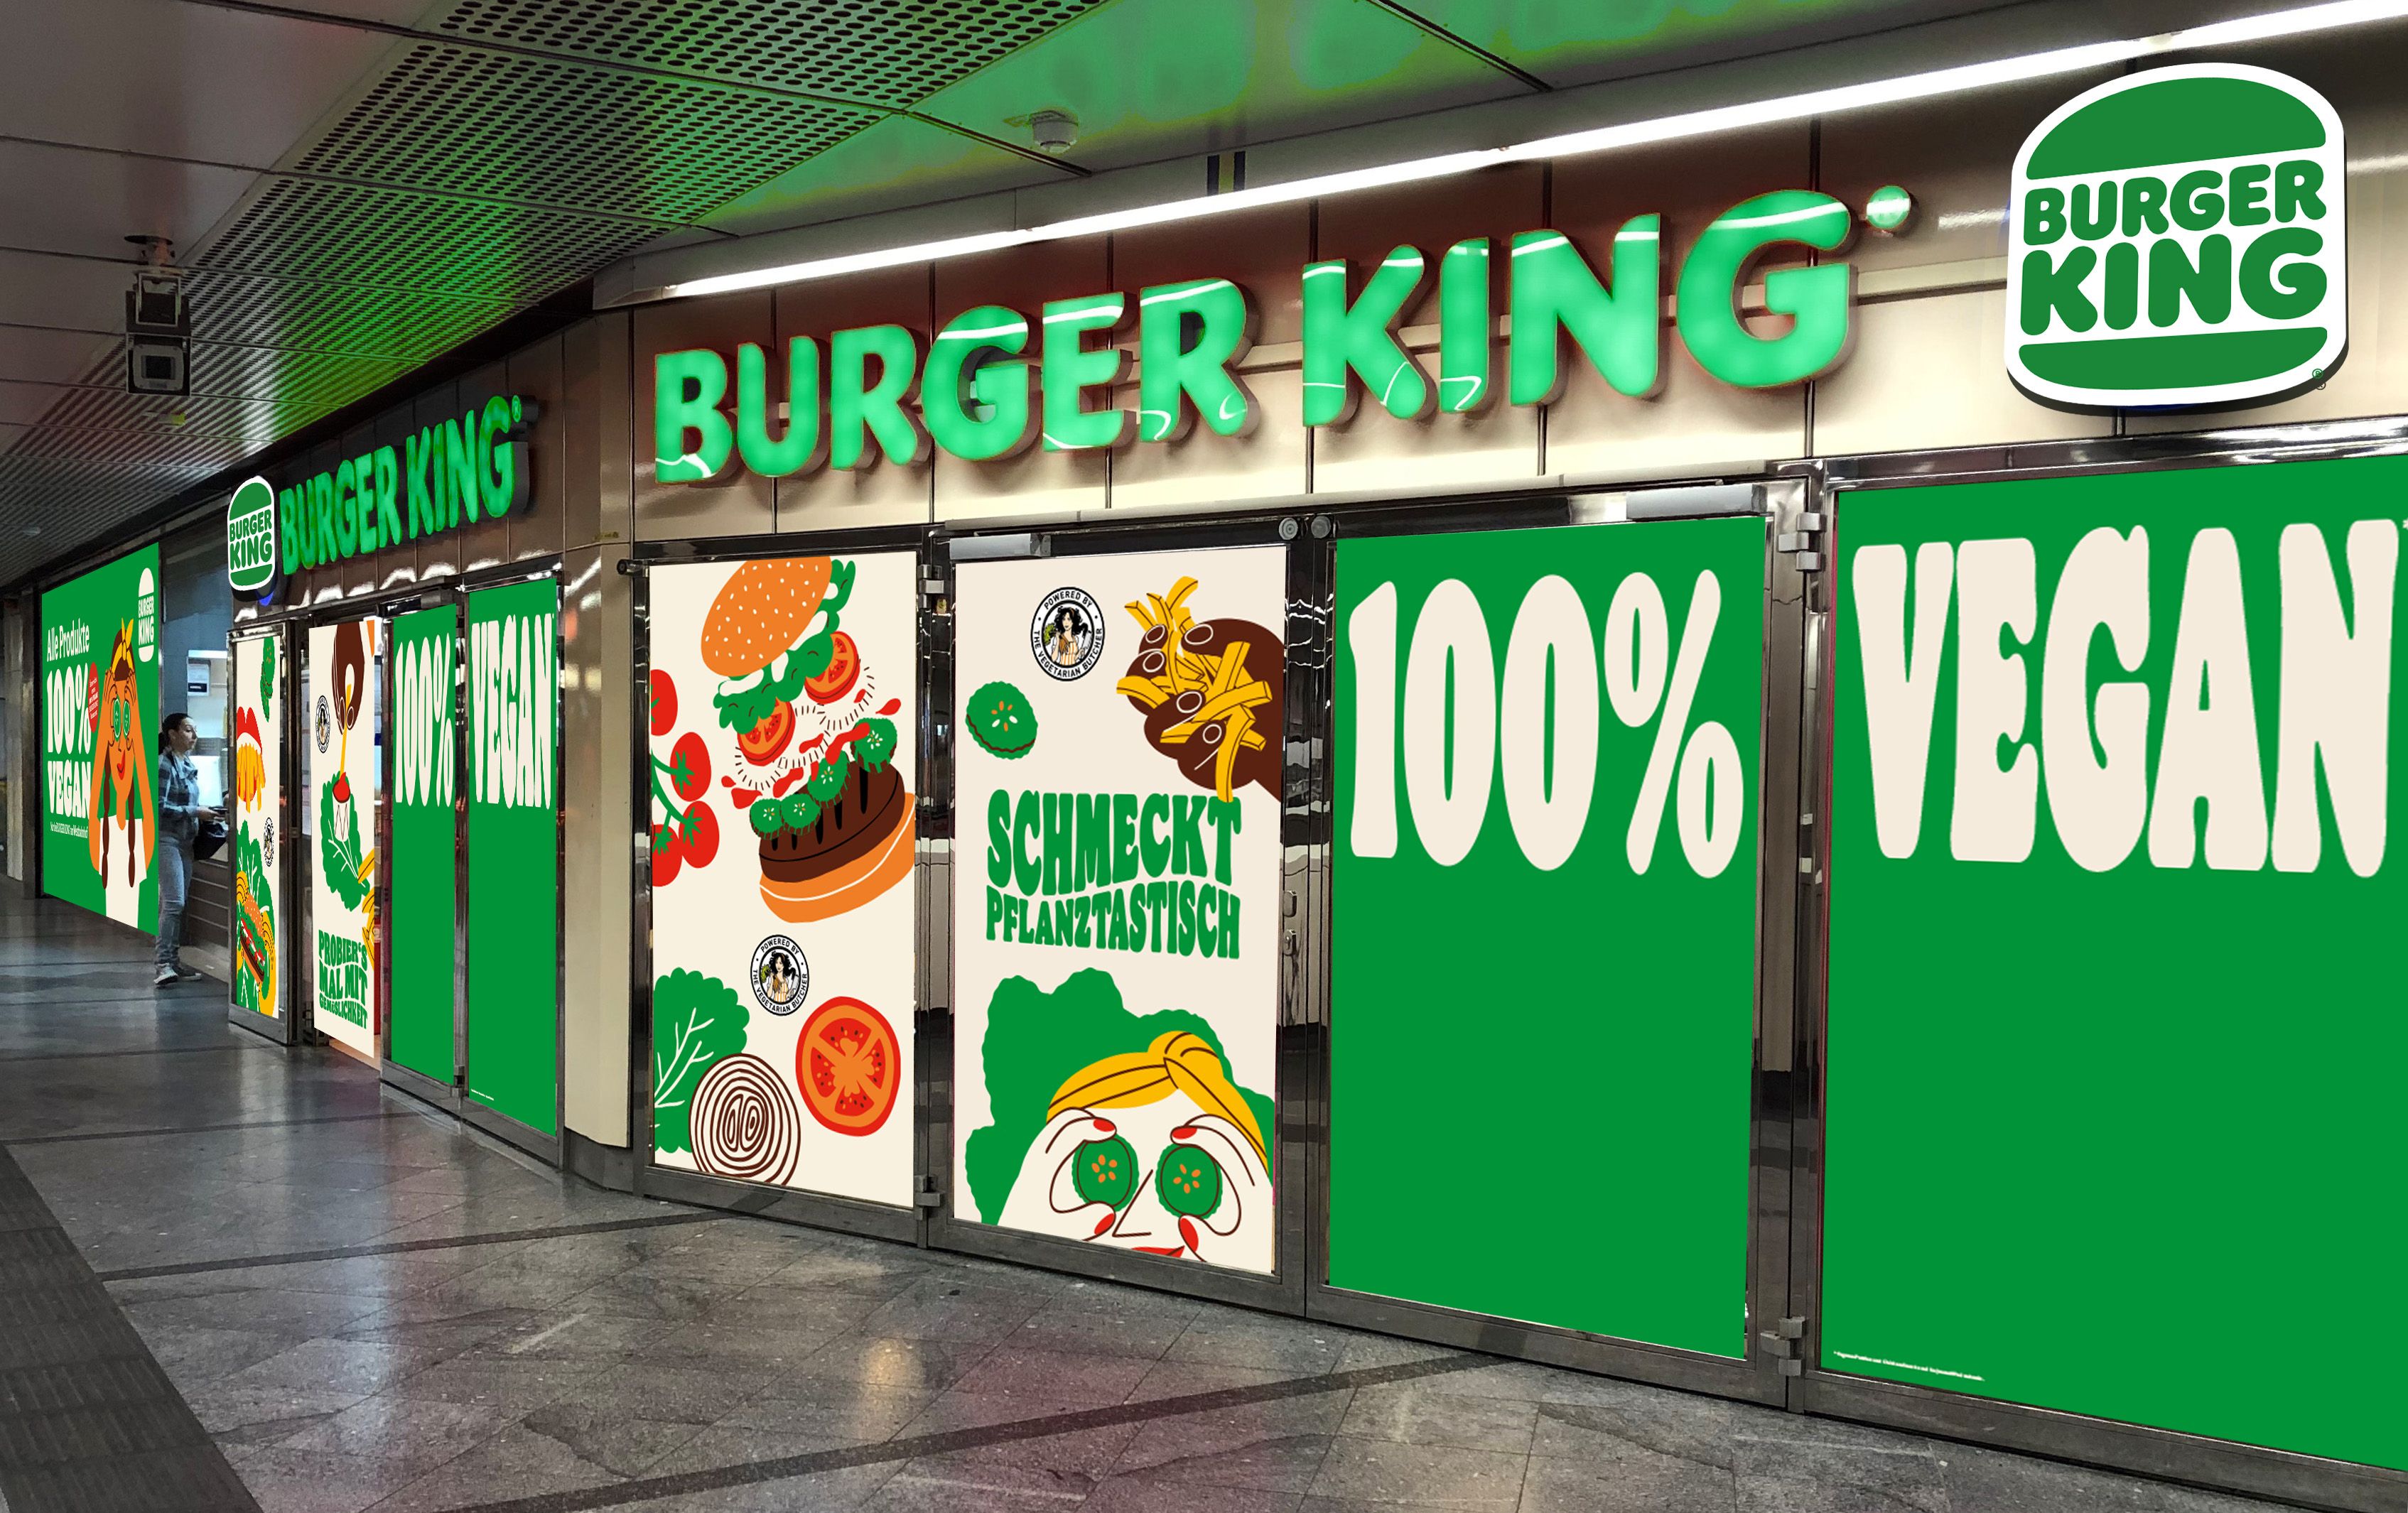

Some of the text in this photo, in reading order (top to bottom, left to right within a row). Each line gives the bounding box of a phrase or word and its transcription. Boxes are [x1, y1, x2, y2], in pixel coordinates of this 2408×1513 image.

[2024, 159, 2327, 246] BURGER
[2020, 227, 2327, 336] KING
[654, 189, 1852, 484] BURGER KING
[279, 396, 514, 575] BURGER KING
[229, 509, 271, 543] BURGER
[230, 532, 272, 570] KING
[1044, 590, 1093, 609] POWERED BY
[47, 618, 90, 662] Alle Produkte
[139, 615, 154, 646] KING
[1038, 651, 1081, 678] VEGETARIAN
[1082, 628, 1102, 670] BUTCHER
[47, 663, 91, 754] 100%
[396, 632, 453, 808] 100%
[1349, 569, 1744, 879] 100%
[48, 759, 91, 820] VEGAN
[987, 789, 1242, 896] SCHMECKT
[760, 938, 799, 955] POWERED BY
[986, 879, 1241, 959] PFLANZTASTISCH
[319, 959, 368, 1006] MAL MIT
[757, 987, 791, 1013] VEGETARIAN
[792, 973, 807, 1008] BUTCHER
